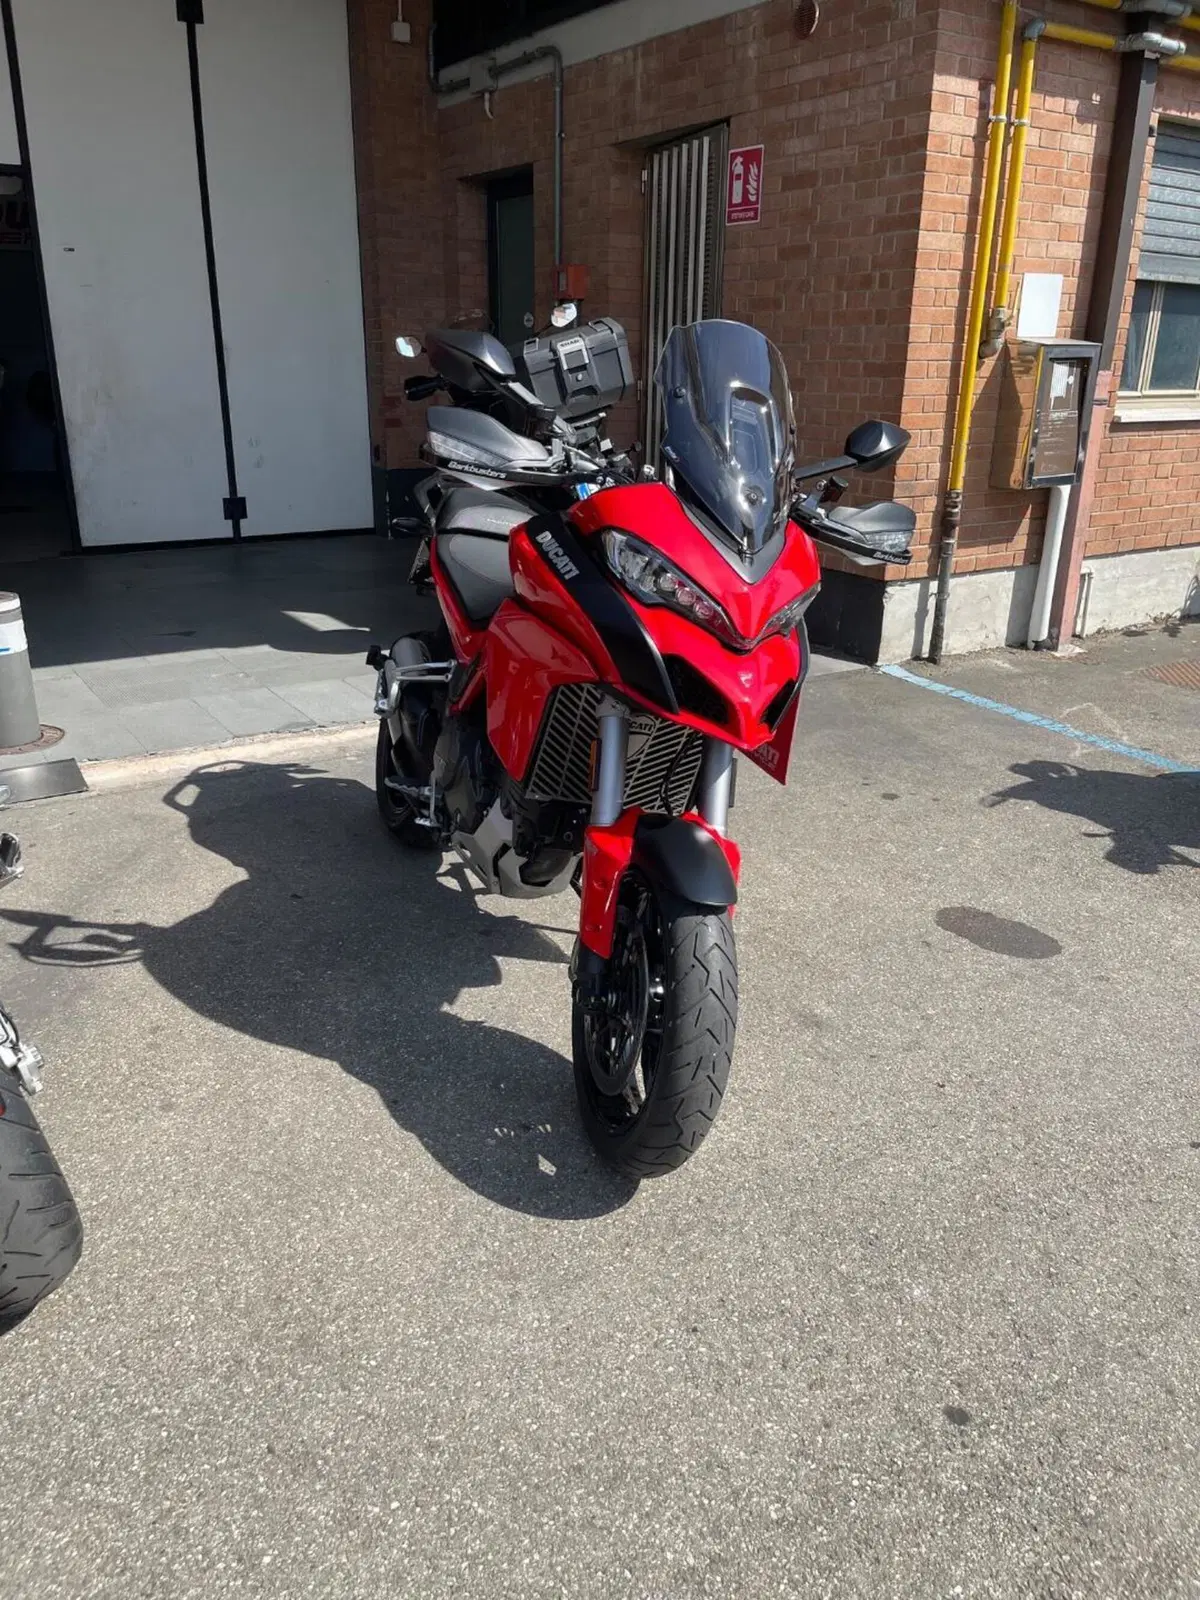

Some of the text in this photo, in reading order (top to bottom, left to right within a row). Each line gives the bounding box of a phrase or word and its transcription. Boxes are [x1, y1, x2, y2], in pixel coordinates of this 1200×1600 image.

[447, 460, 508, 479] Barkbusters
[535, 530, 580, 580] DUCATI
[629, 720, 654, 732] CATI
